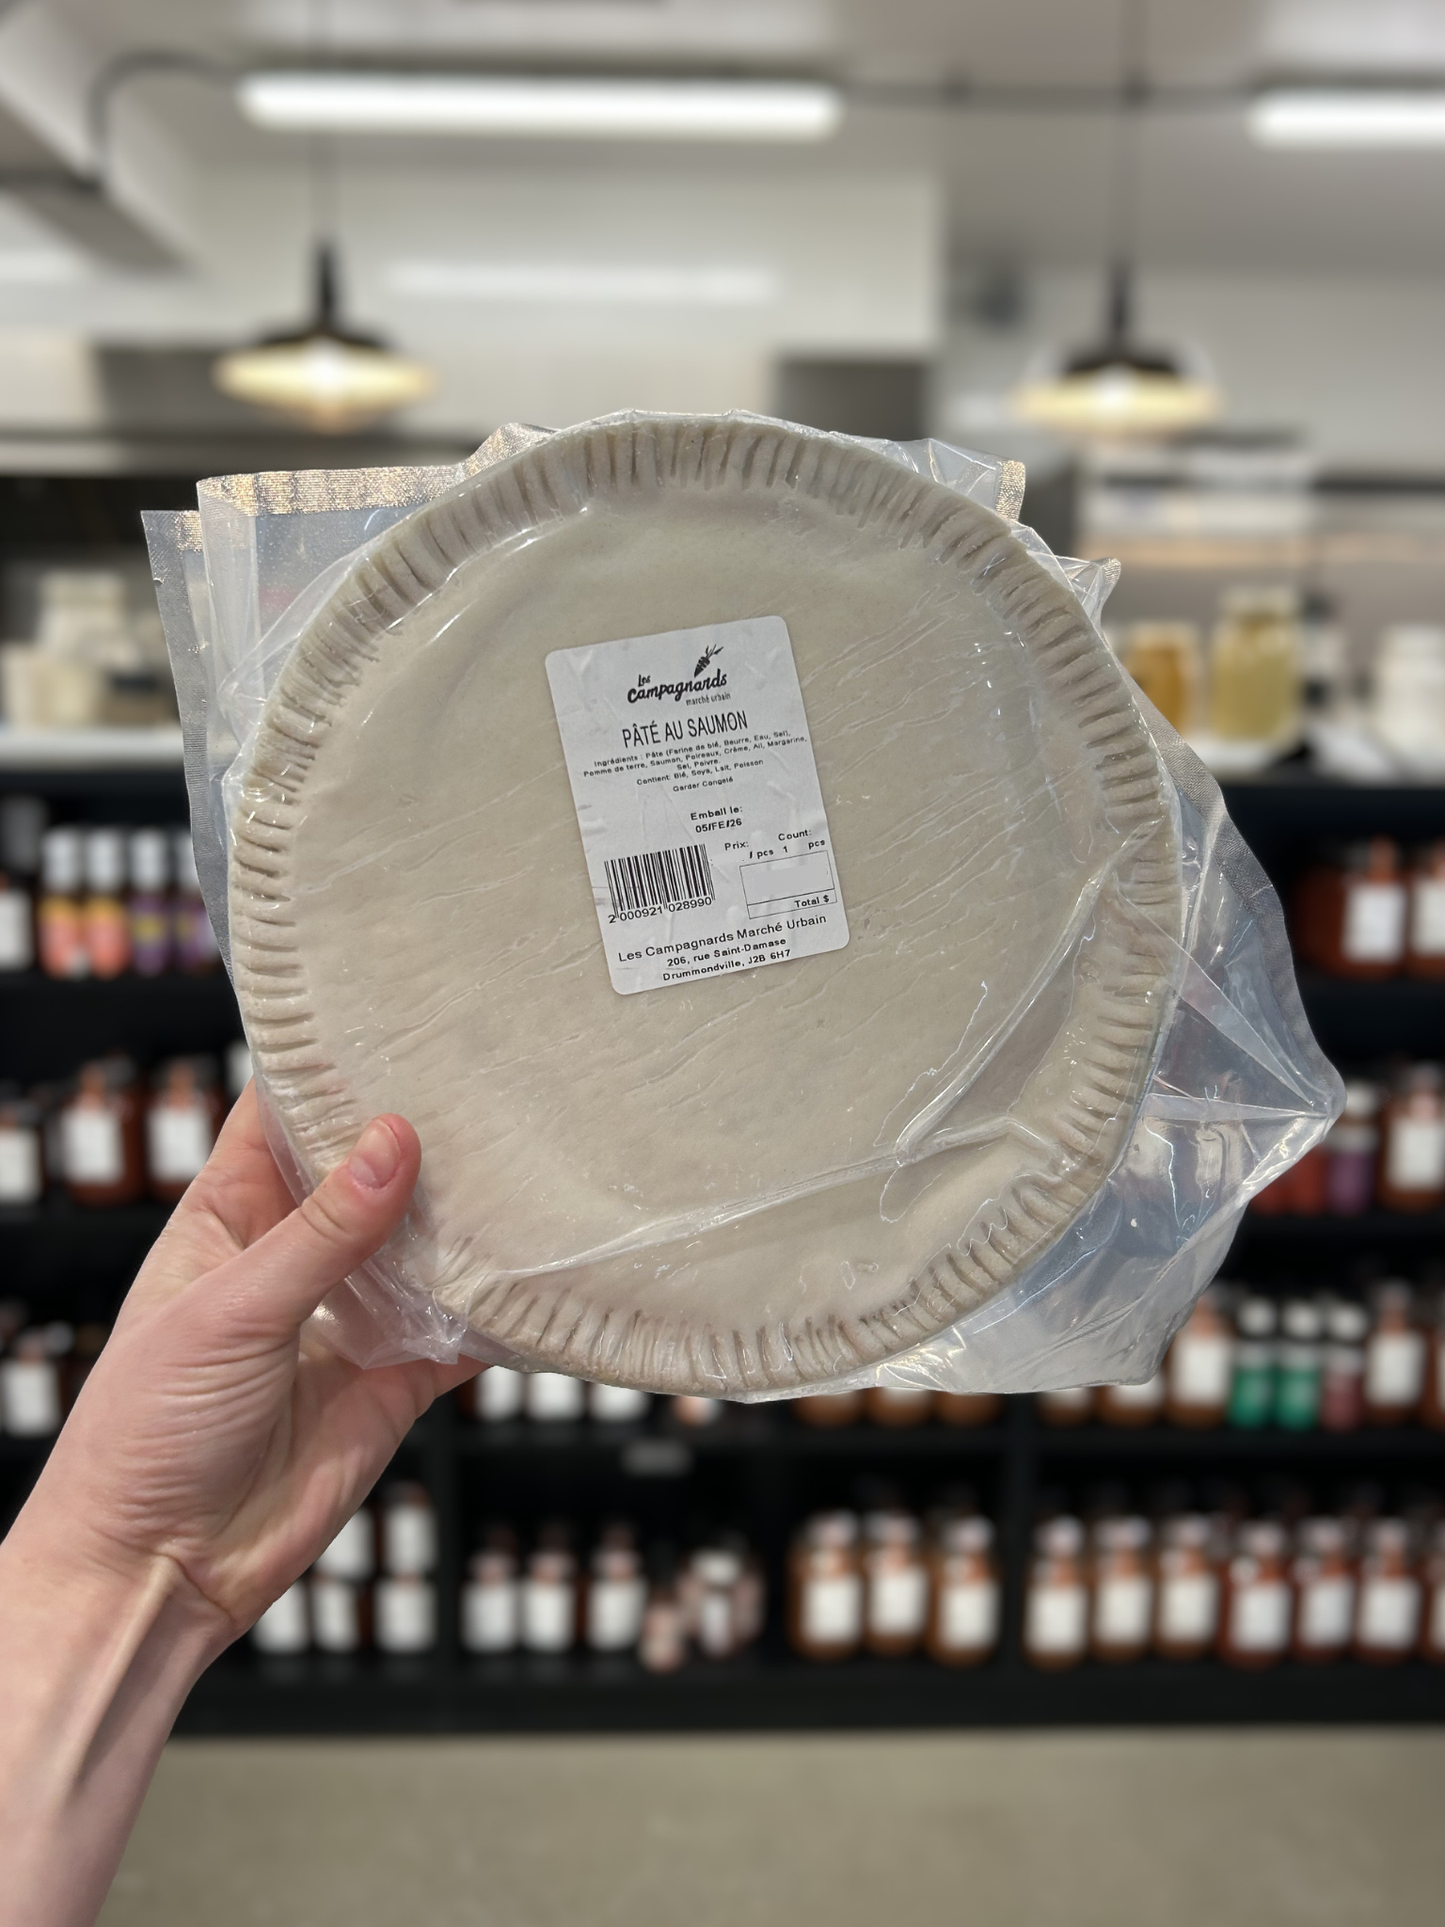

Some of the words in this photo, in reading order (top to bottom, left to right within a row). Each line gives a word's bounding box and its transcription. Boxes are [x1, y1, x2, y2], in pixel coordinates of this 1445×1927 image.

[686, 696, 710, 706] marché
[711, 692, 731, 703] urbain
[622, 720, 661, 748] PÂTÉ
[665, 720, 683, 742] AU
[687, 710, 748, 737] SAUMON
[646, 751, 663, 759] Pâte
[666, 746, 693, 757] (Farine
[708, 741, 721, 749] blé,
[724, 737, 752, 746] Beurre,
[583, 768, 612, 777] Pomme
[626, 763, 648, 771] terre,
[650, 757, 683, 766] Saumon,
[724, 746, 751, 754] Crème,
[767, 736, 808, 747] Margarine,
[637, 775, 671, 785] Contient:
[674, 771, 689, 779] Blé,
[691, 768, 713, 776] Soya,
[715, 765, 732, 773] Lait,
[734, 760, 764, 769] Poisson
[673, 783, 700, 792] Garder
[702, 776, 734, 787] Congelé
[690, 807, 727, 820] Emball
[730, 806, 743, 814] le:
[695, 818, 742, 833] 05/FE/26
[778, 829, 812, 841] Count:
[724, 841, 749, 850] Prix:
[808, 840, 825, 850] pcs
[756, 849, 774, 860] pcs
[608, 914, 616, 923] 2
[620, 906, 663, 921] 000921
[668, 896, 712, 912] 028990
[794, 897, 820, 908] Total
[823, 895, 829, 903] $
[618, 951, 642, 962] Les
[645, 933, 734, 956] Campagnards
[737, 922, 783, 939] Marché
[787, 914, 826, 930] Urbain
[667, 956, 690, 967] 206,
[694, 953, 710, 962] rue
[714, 939, 786, 957] Saint-Damase
[663, 960, 745, 981] Drummondville,
[748, 954, 766, 964] J2B
[770, 949, 791, 960] 6H7
